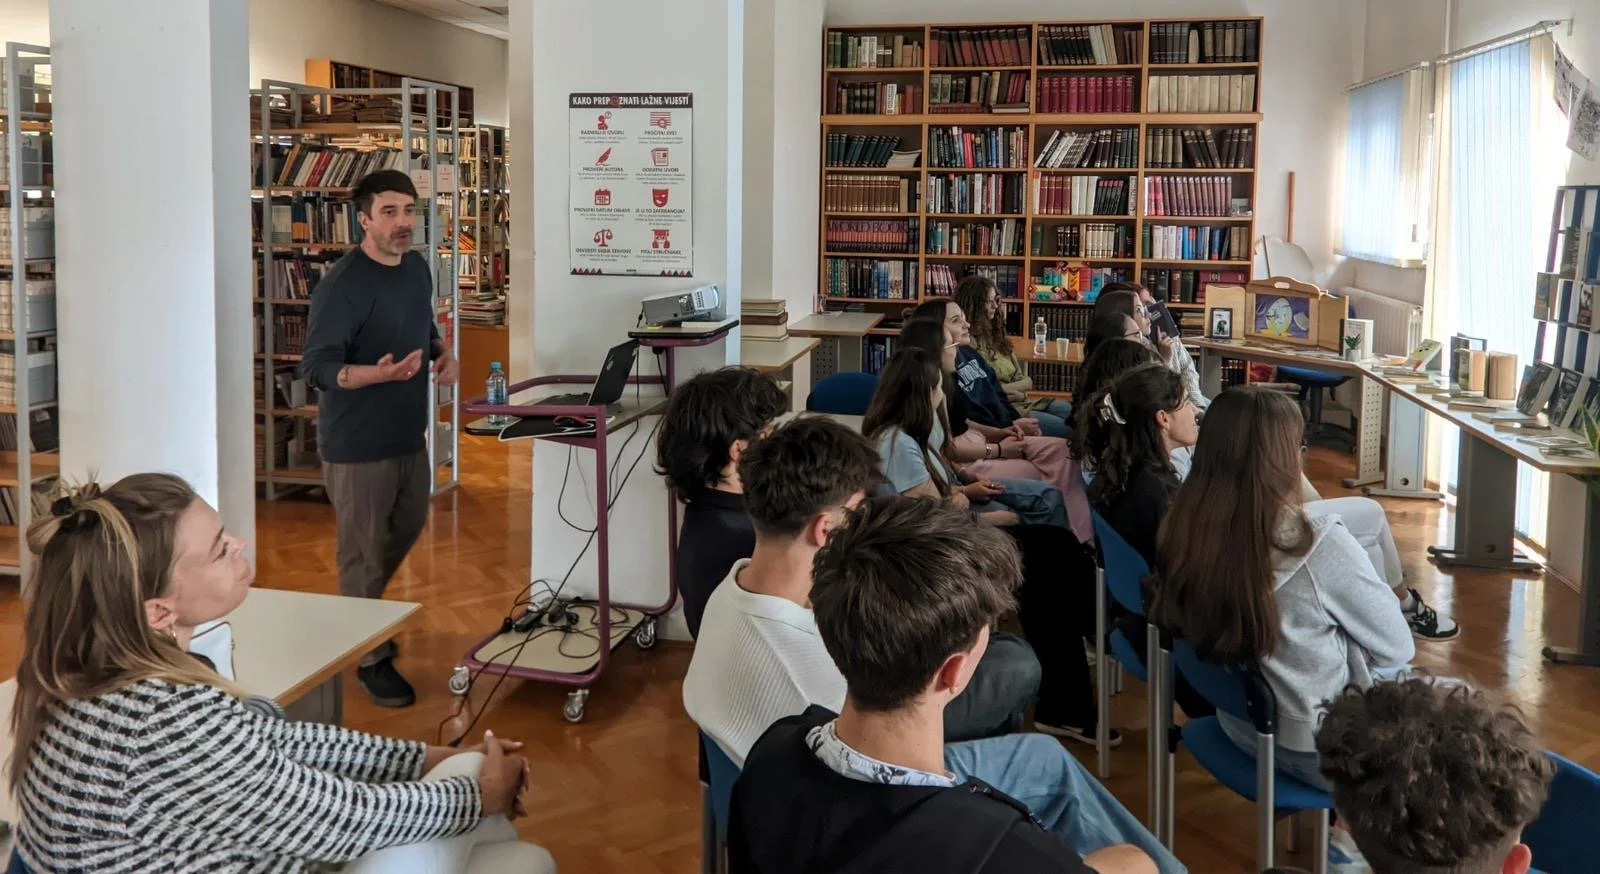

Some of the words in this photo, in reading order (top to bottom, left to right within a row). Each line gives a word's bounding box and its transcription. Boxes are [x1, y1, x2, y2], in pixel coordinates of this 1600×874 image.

[573, 96, 592, 105] KAKO
[640, 95, 663, 105] LAŽNE
[665, 96, 689, 105] VIJESTI
